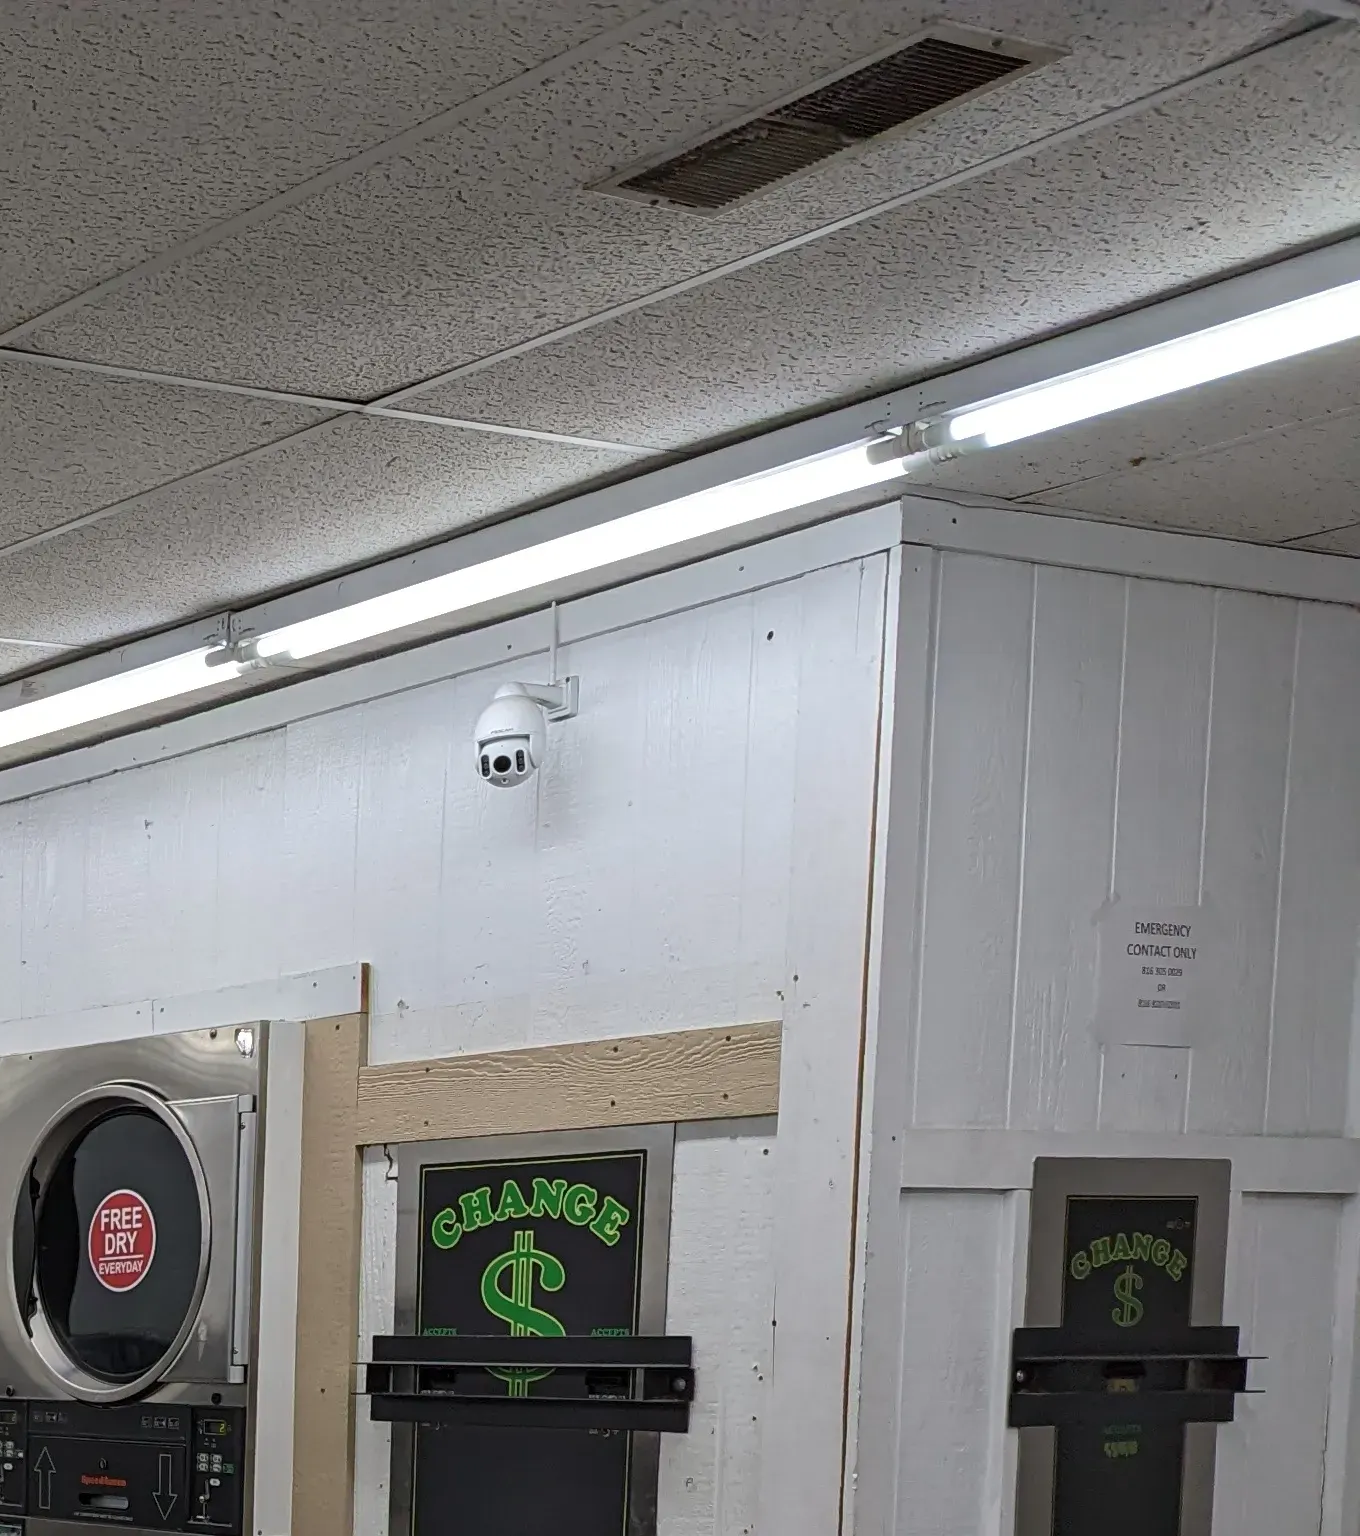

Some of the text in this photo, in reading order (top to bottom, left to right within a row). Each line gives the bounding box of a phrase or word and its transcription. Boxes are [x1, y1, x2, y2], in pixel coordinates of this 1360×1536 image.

[1135, 922, 1191, 937] EMERGENCY
[1127, 944, 1197, 959] CONTACT ONLY
[100, 1206, 143, 1231] FREE
[432, 1178, 630, 1249] CHANGE
[104, 1231, 138, 1255] DRY
[99, 1260, 144, 1275] EVERYDAY
[1071, 1232, 1188, 1281] CHANGE
